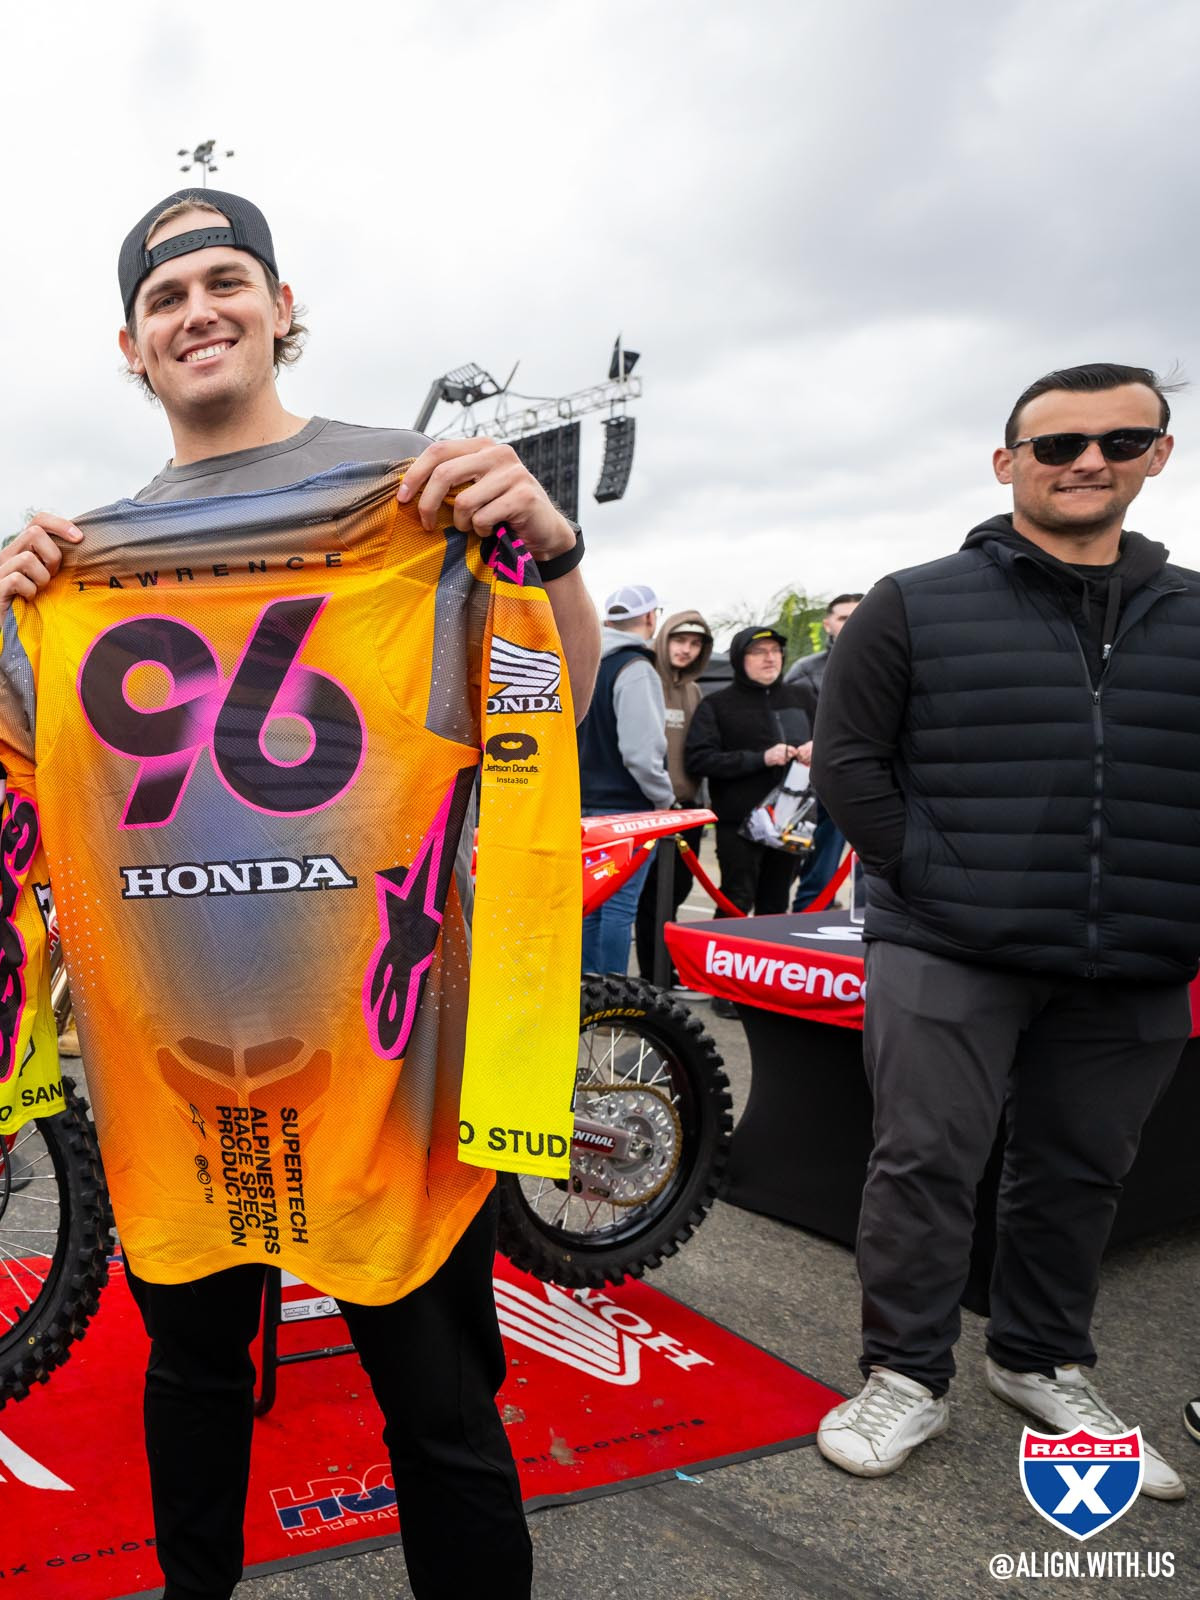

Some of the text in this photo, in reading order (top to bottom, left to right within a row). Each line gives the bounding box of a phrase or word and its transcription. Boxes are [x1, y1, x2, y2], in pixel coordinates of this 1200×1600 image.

[76, 592, 368, 831] 96
[496, 776, 529, 785] Insta360
[612, 815, 682, 834] DUNLOP
[121, 857, 355, 898] HONDA
[705, 940, 867, 1002] lawrenc
[580, 1008, 647, 1026] DUNLOP
[21, 1084, 64, 1107] SAN
[488, 1127, 572, 1159] STUD
[574, 1130, 614, 1148] NTHAL
[215, 1105, 247, 1247] PRODUCTION
[233, 1106, 261, 1229] RACE SPEC
[250, 1106, 281, 1255] ALPINESTARS
[280, 1106, 309, 1244] SUPERTECH
[286, 1517, 359, 1540] Honda
[45, 1537, 157, 1568] CONCE
